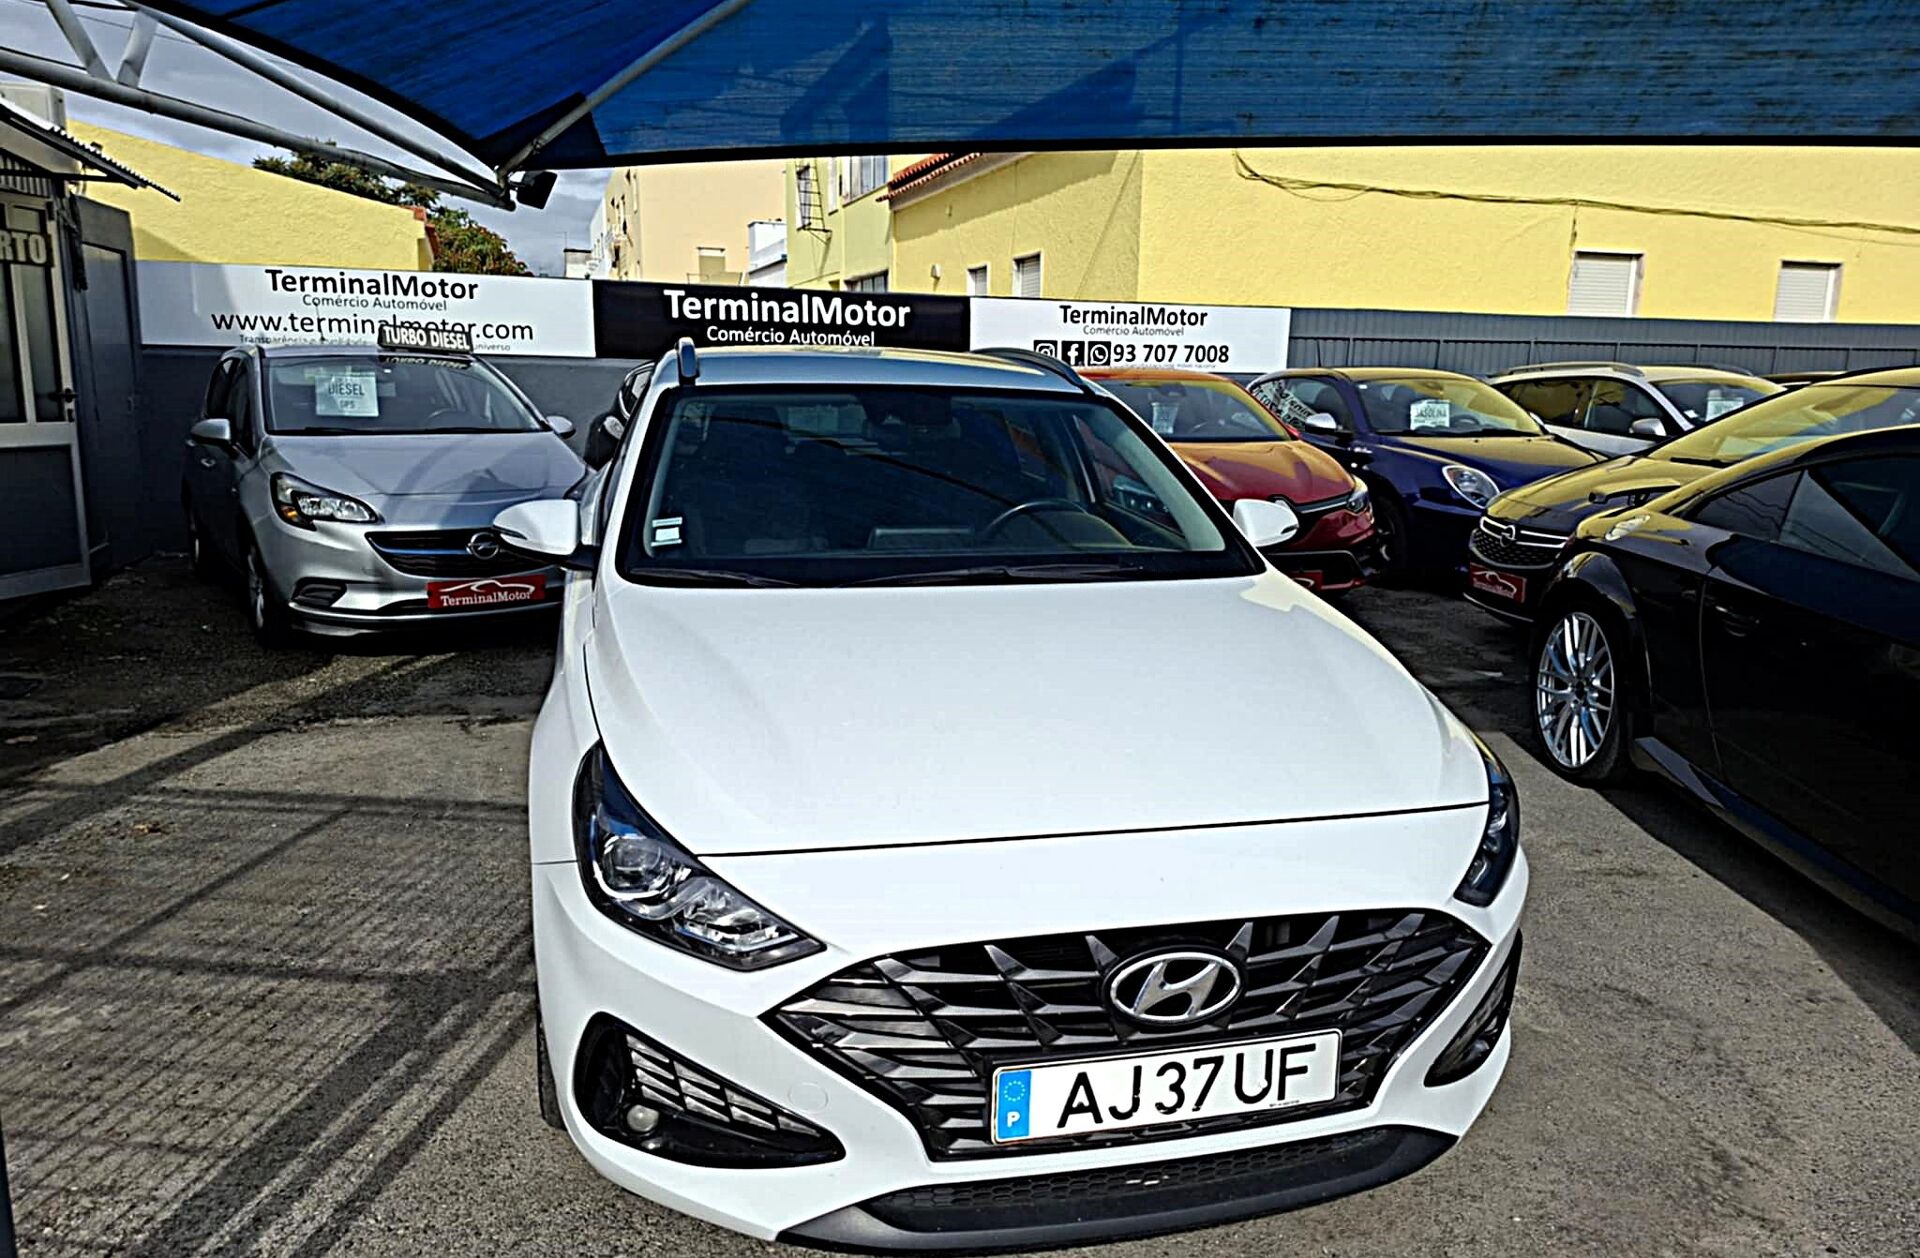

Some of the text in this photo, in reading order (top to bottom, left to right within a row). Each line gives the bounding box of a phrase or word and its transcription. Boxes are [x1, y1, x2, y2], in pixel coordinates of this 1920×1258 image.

[265, 268, 479, 300] TerminalMotor
[302, 293, 447, 312] Comércio Automóvel
[663, 288, 911, 328] TerminalMotor
[1059, 304, 1209, 327] TerminalMotor
[211, 313, 534, 341] www.terminlotor.com
[706, 325, 876, 347] Comércio Automóvel
[1082, 324, 1185, 338] Comércio Automóvel
[382, 326, 428, 347] TURBO
[429, 329, 471, 350] DIESEL
[1113, 344, 1230, 364] 93 707 7008
[328, 382, 366, 397] DIESEL
[440, 590, 532, 607] TerminalMotor
[1006, 1110, 1021, 1128] P
